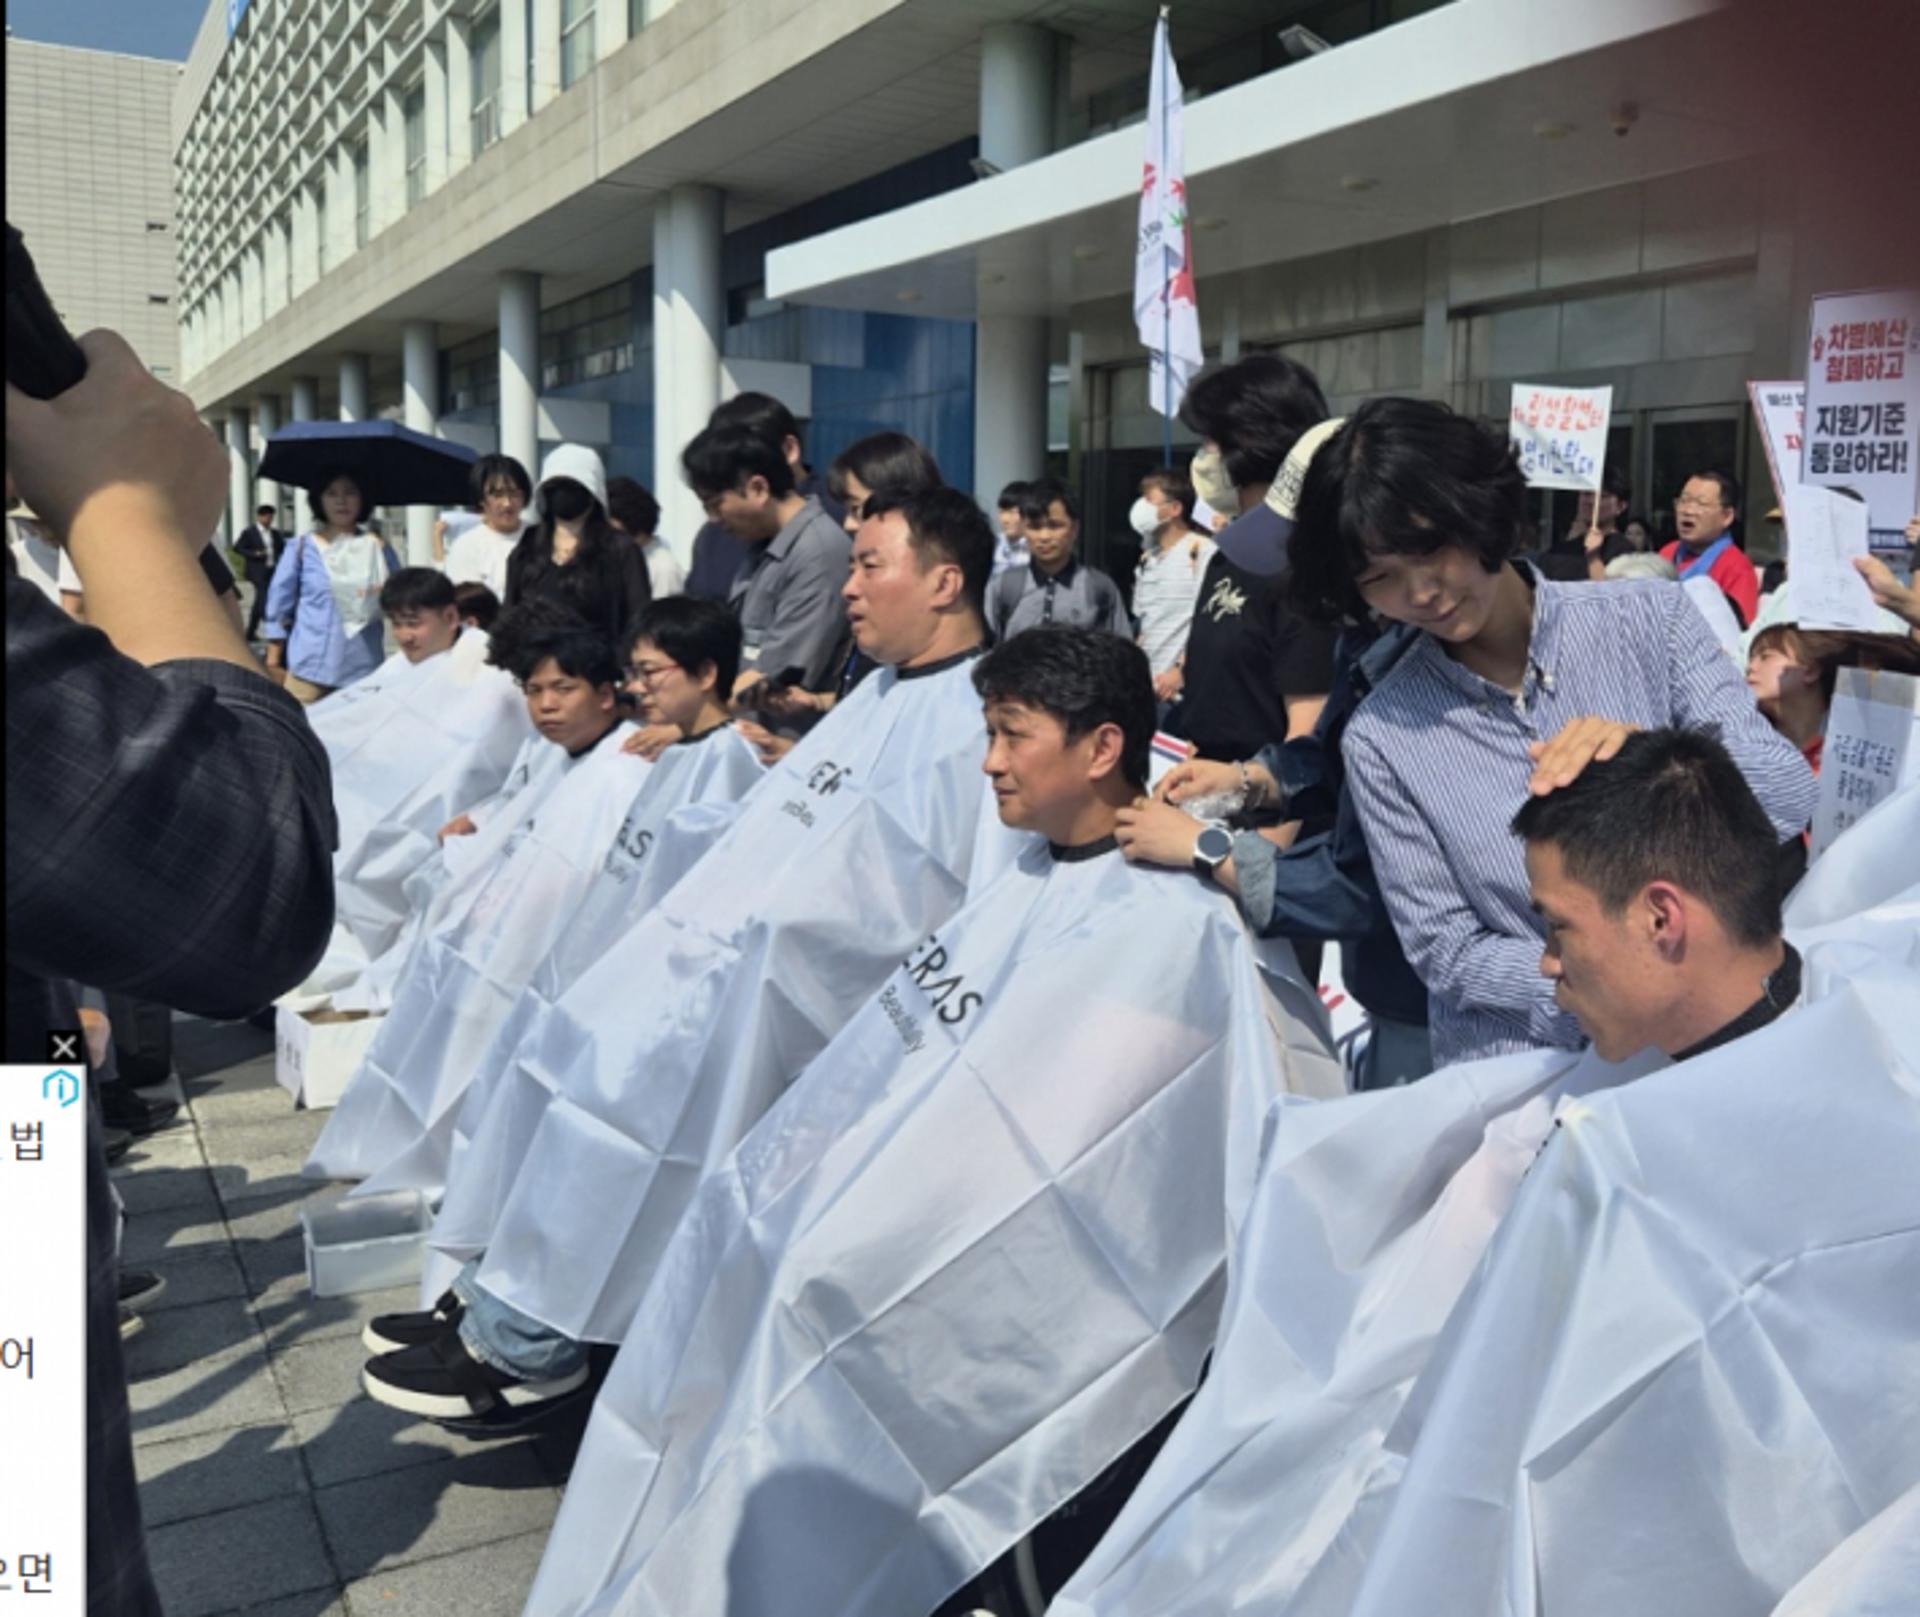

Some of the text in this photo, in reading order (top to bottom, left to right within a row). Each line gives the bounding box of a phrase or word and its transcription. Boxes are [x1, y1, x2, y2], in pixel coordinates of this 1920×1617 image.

[1827, 317, 1907, 351] 차별예산
[1816, 402, 1906, 437] 지원기준
[1810, 440, 1908, 474] 통일하라!
